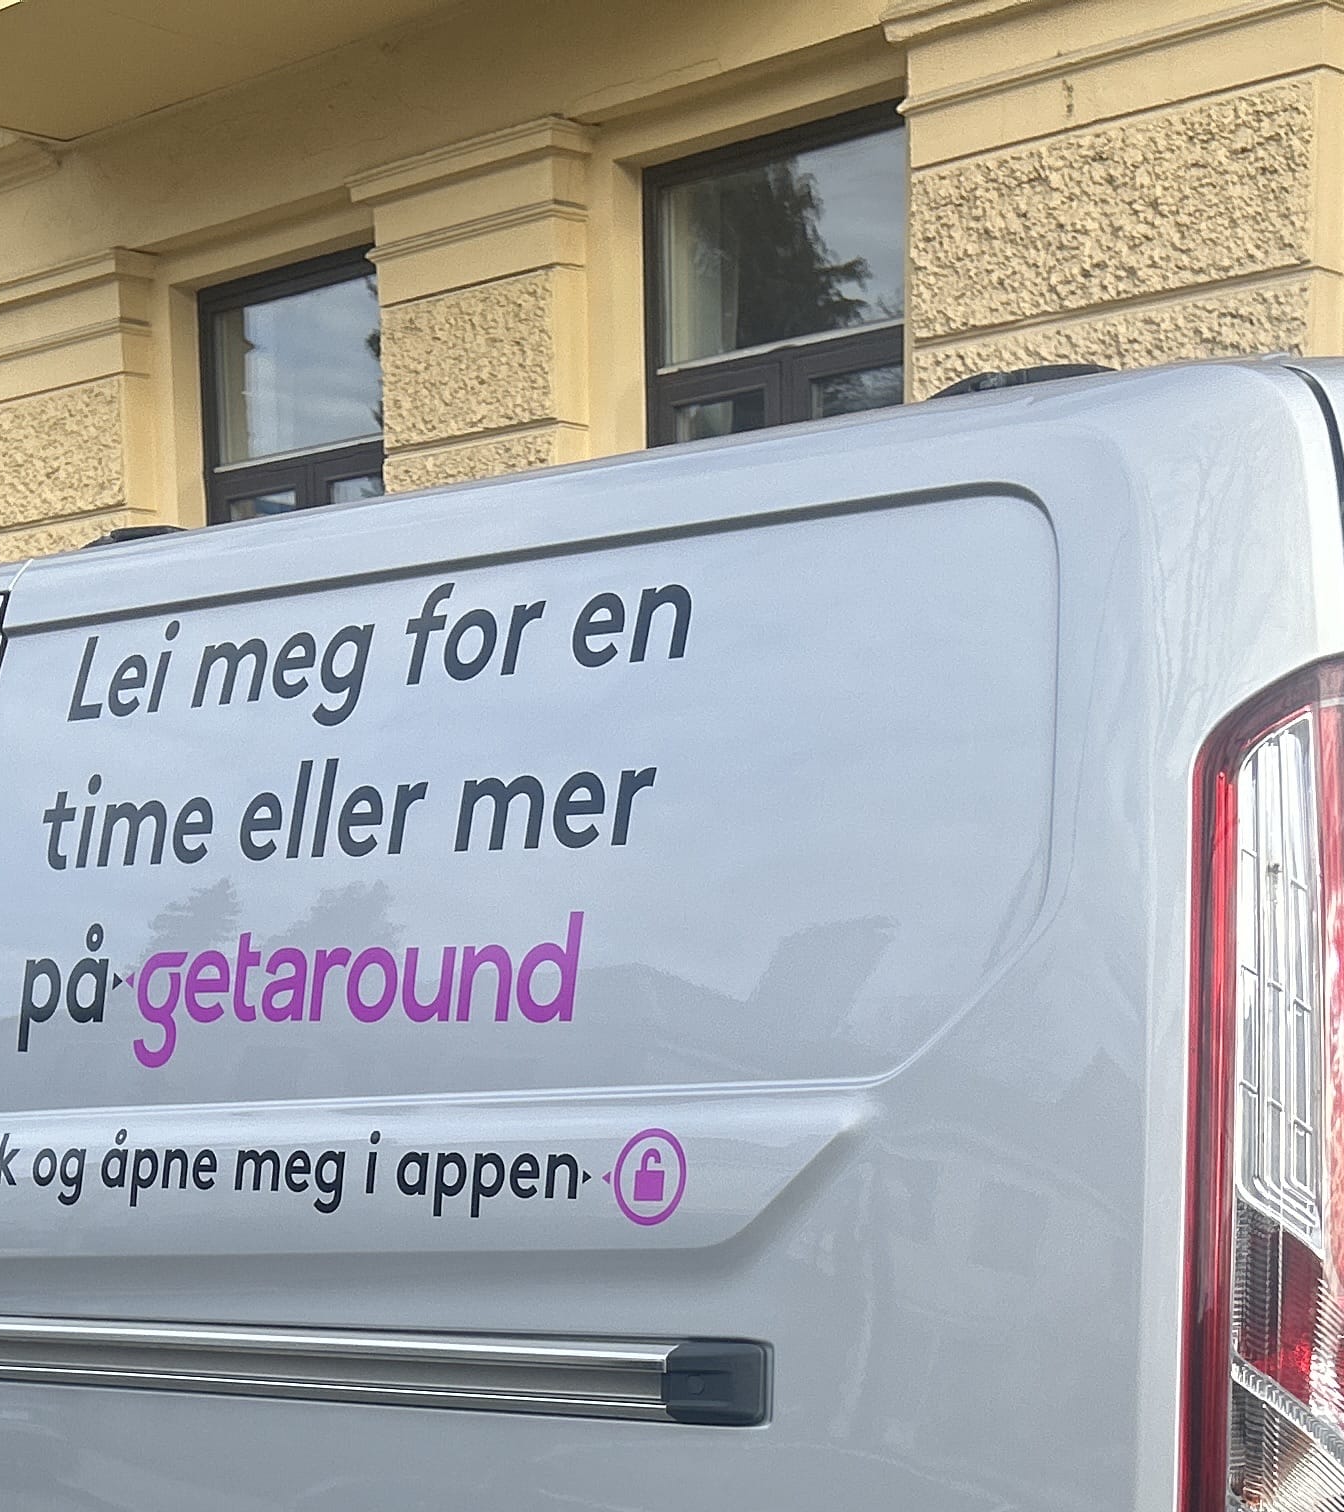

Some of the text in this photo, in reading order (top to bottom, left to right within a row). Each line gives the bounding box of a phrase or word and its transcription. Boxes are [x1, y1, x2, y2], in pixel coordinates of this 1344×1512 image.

[67, 582, 693, 727] Lei meg for en
[43, 757, 658, 870] time eller mer
[17, 911, 585, 1070] på getaround
[32, 1147, 87, 1207] og
[101, 1127, 218, 1209] åpne
[233, 1148, 346, 1215] meg
[365, 1130, 381, 1195] i
[396, 1150, 580, 1219] appen
